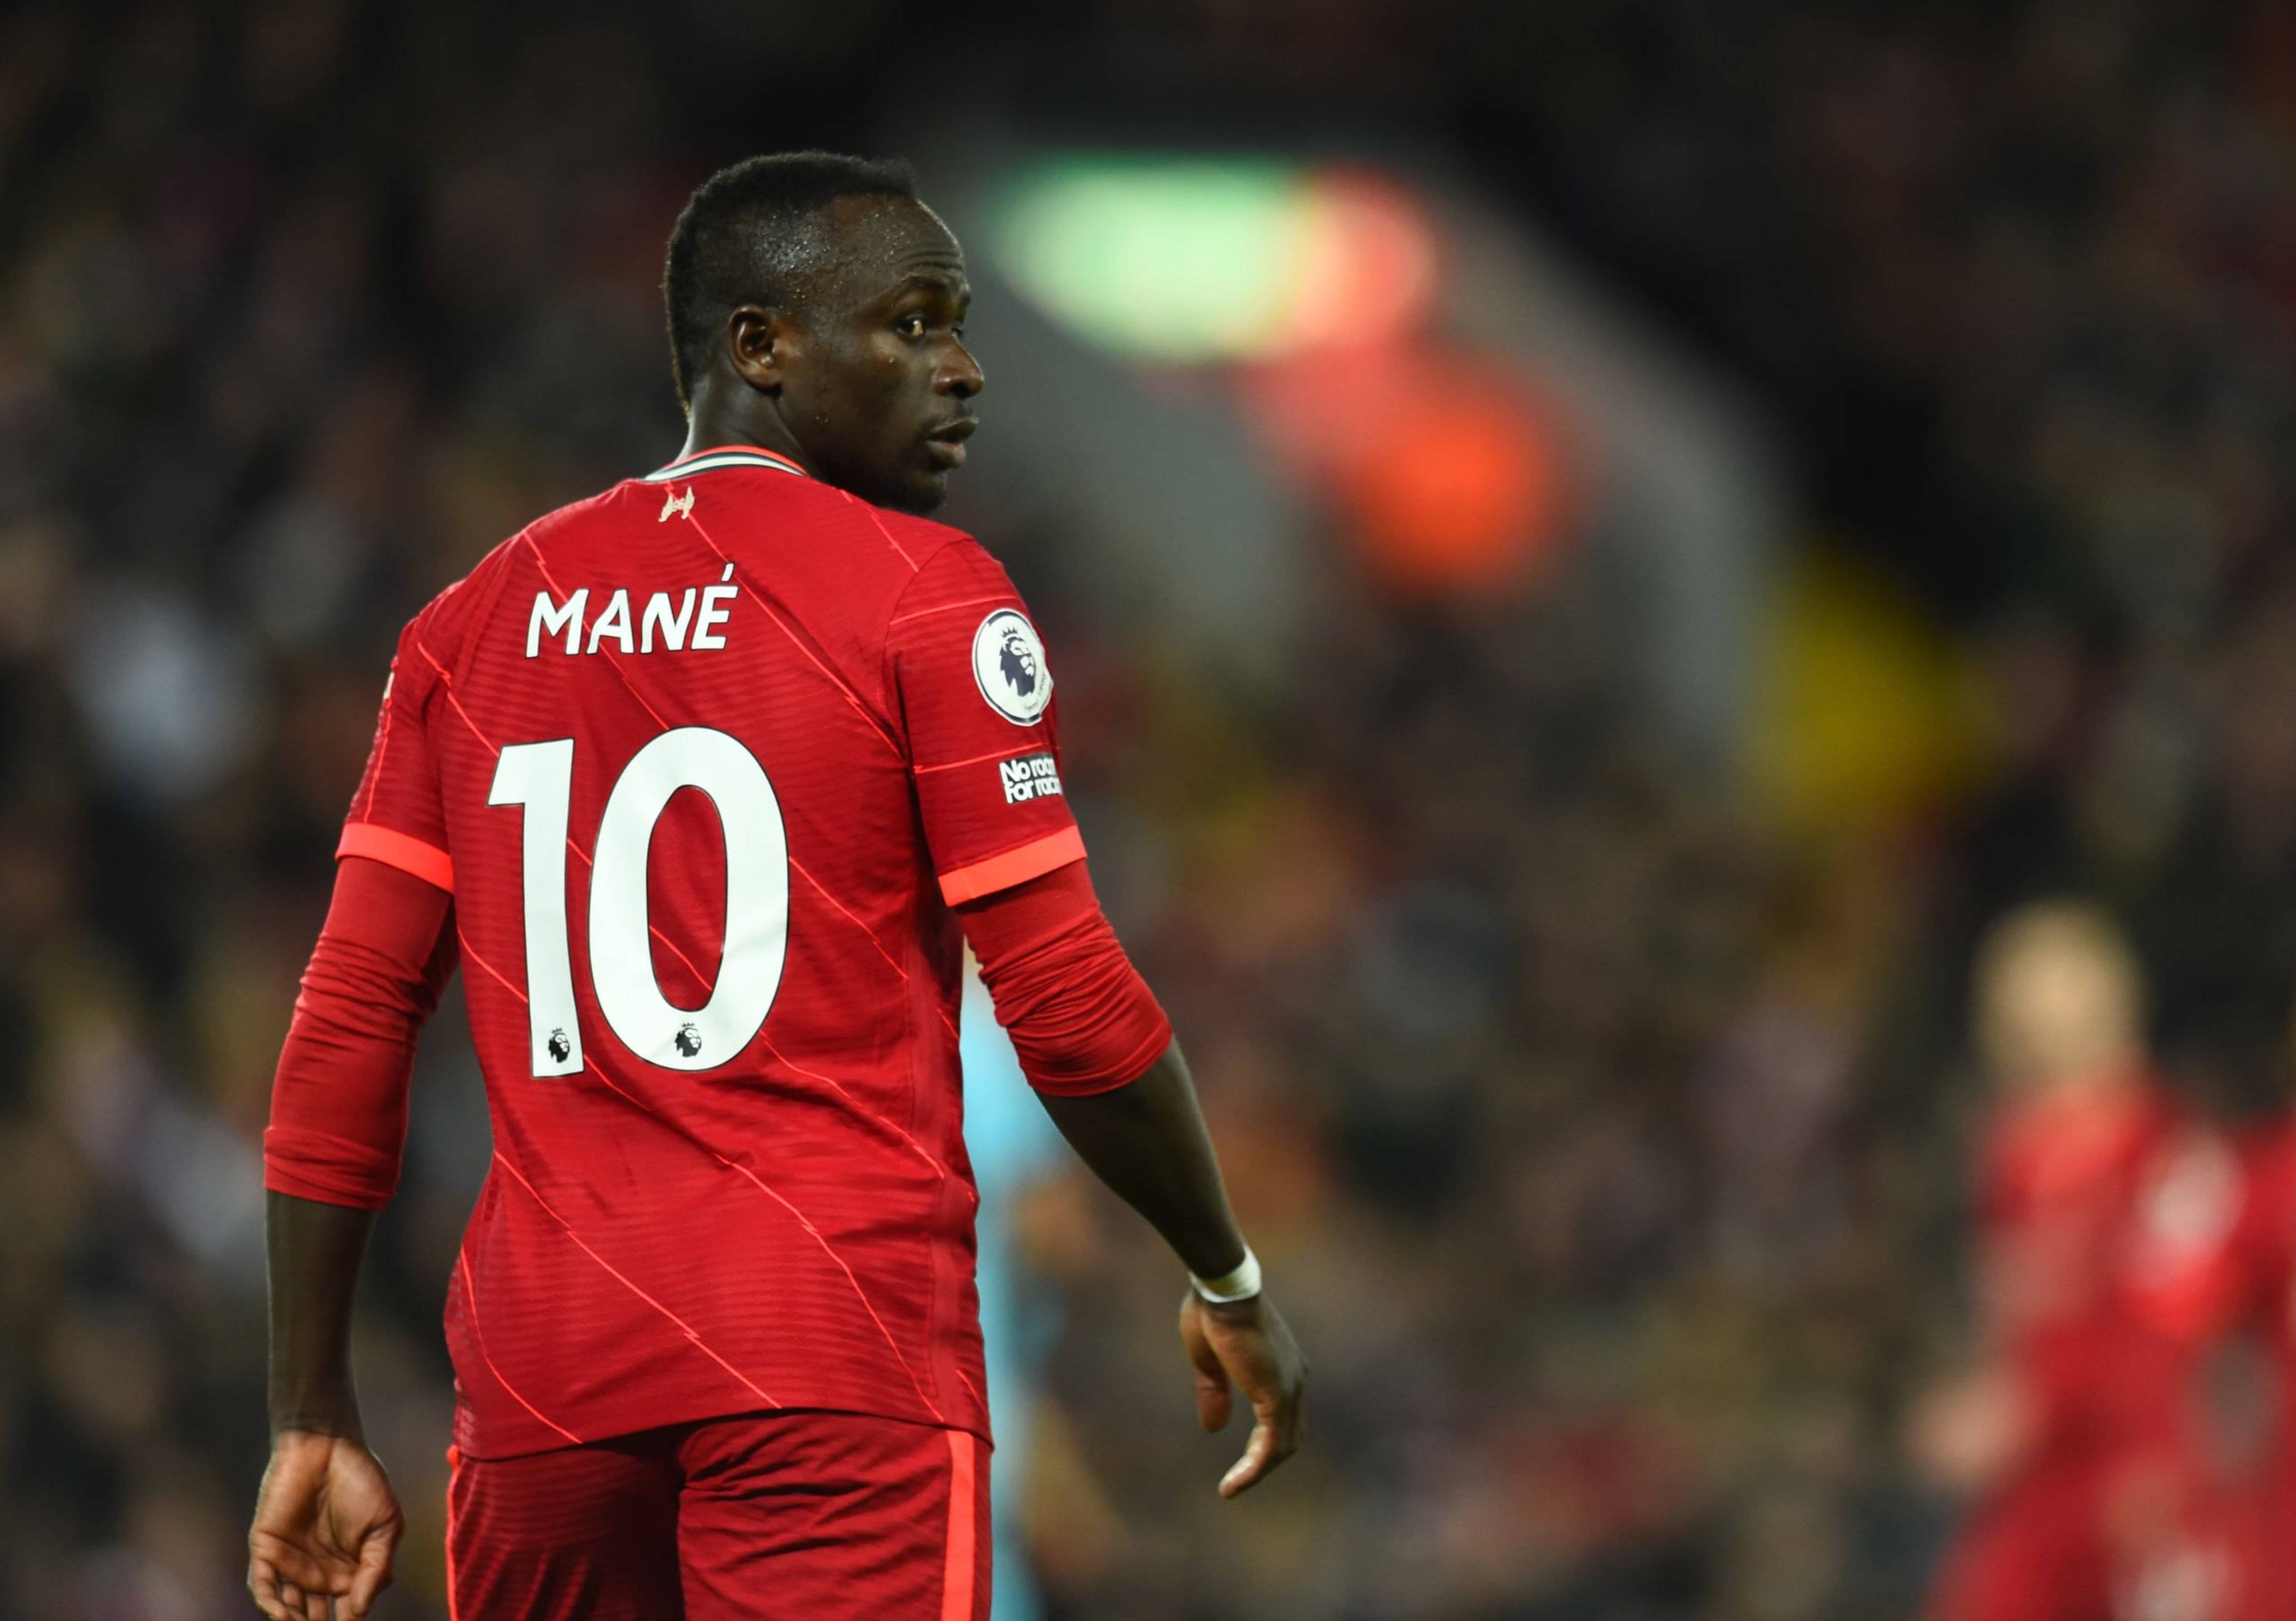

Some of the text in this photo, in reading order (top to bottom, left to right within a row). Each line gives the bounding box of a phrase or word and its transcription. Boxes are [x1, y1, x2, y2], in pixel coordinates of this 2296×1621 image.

[525, 562, 738, 659] MANÉ
[999, 759, 1031, 782] No
[1004, 780, 1034, 804] For
[487, 726, 790, 1079] 10
